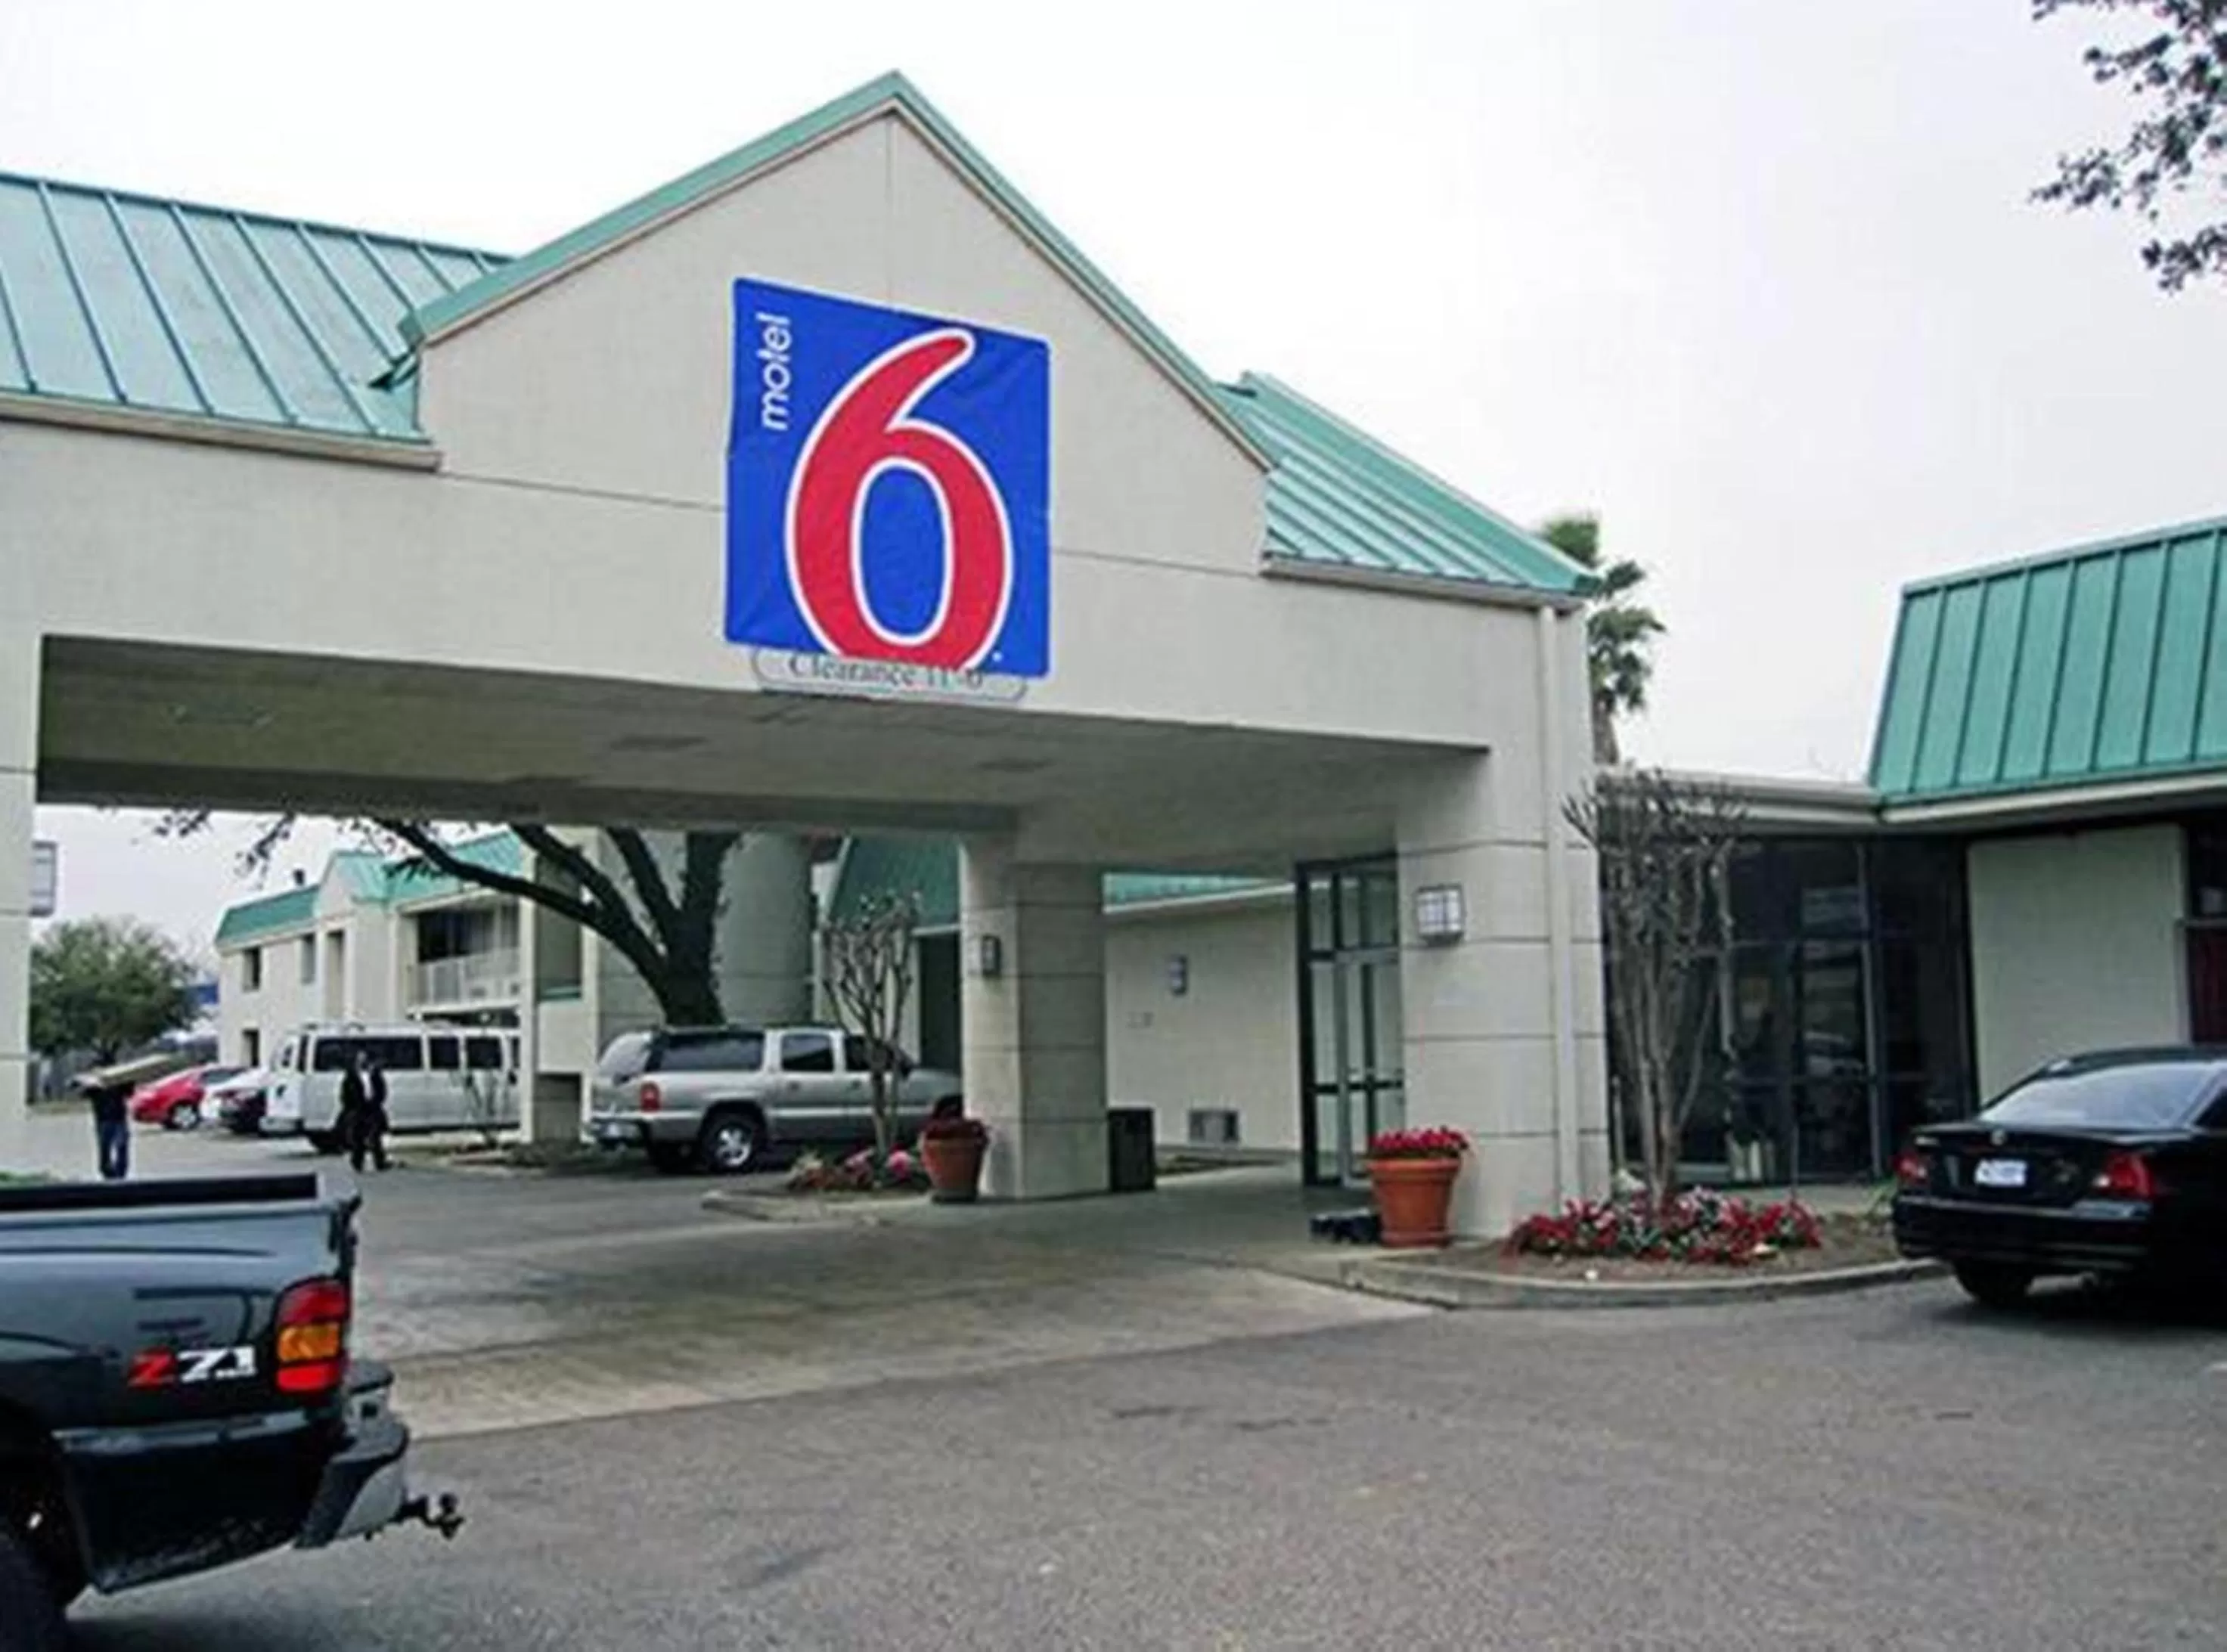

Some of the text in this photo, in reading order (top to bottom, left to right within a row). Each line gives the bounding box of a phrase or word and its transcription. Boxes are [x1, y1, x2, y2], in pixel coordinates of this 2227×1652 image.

[756, 311, 1013, 671] motel 6
[129, 1346, 256, 1389] Z71
